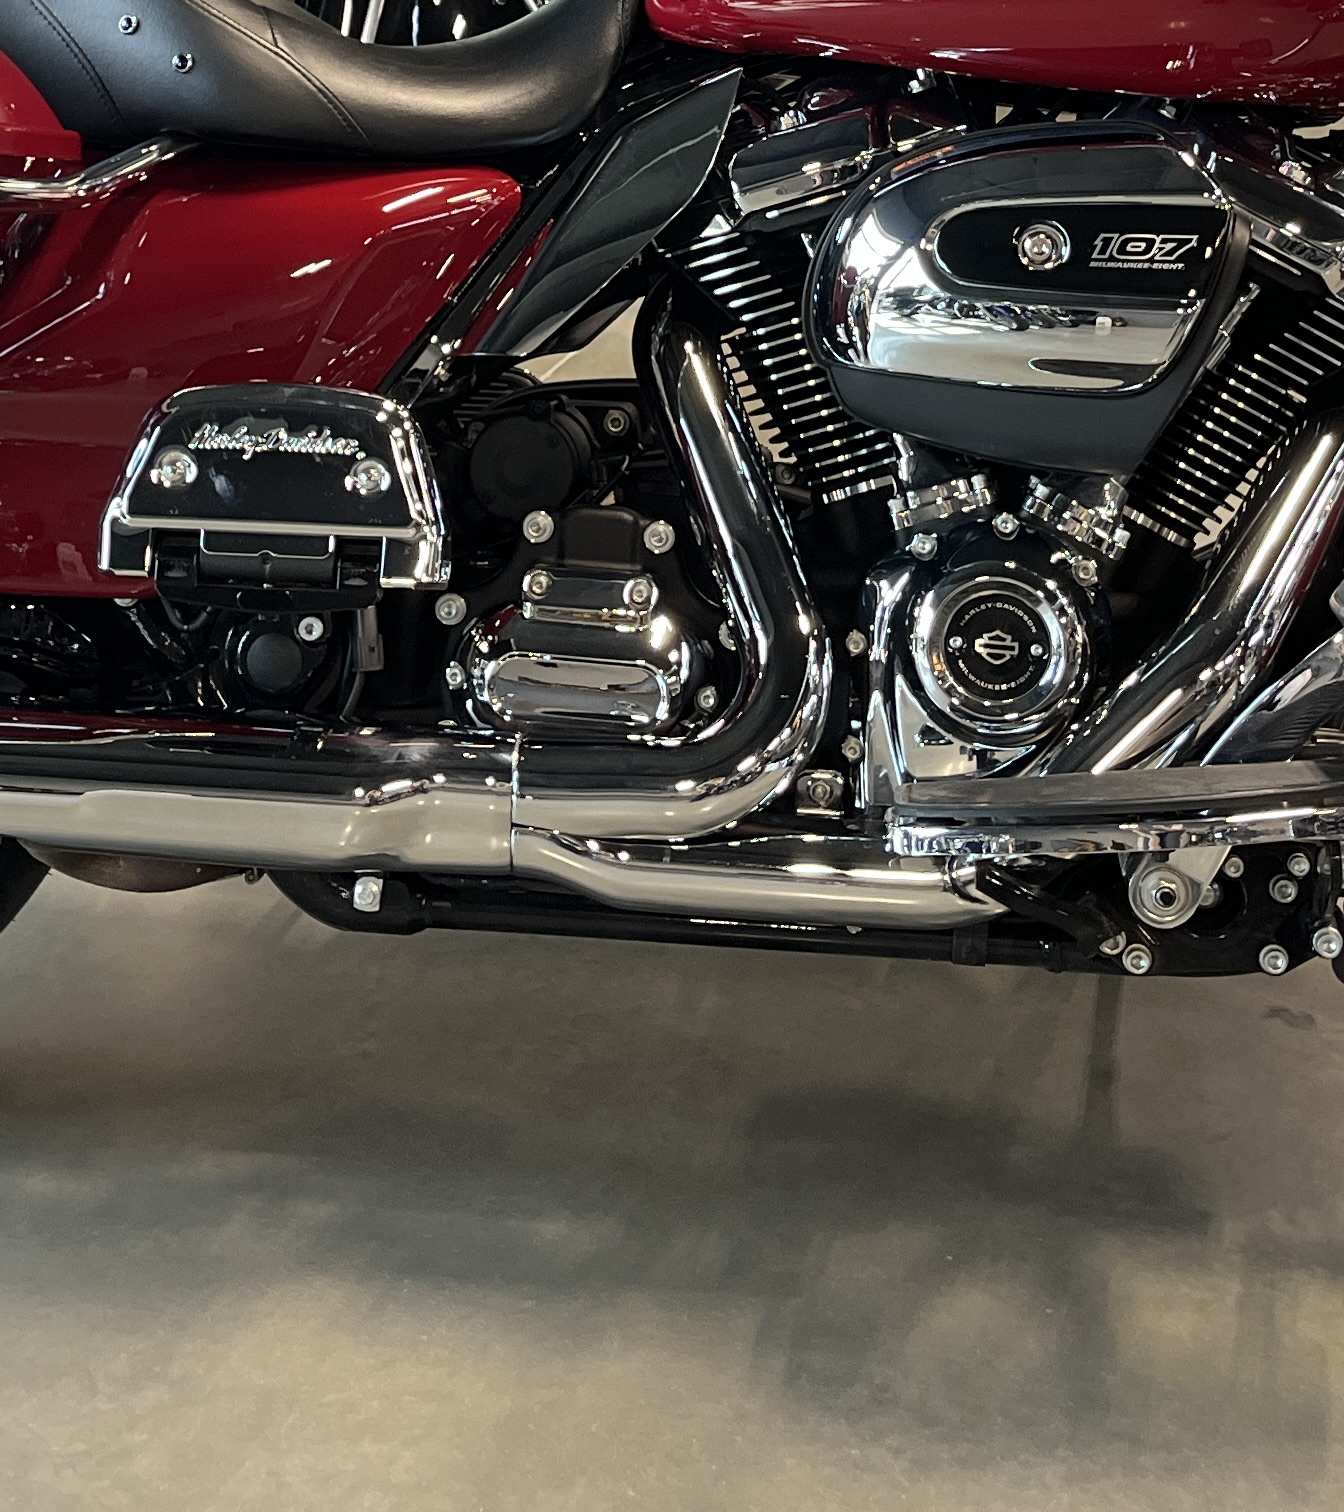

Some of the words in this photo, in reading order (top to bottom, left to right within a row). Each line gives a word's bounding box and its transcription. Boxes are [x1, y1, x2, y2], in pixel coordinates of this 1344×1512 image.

[1091, 233, 1199, 260] 107
[959, 602, 1037, 633] HARLEY-DAVIDSON
[958, 659, 1036, 691] MILWAUKEE-EIGHT
